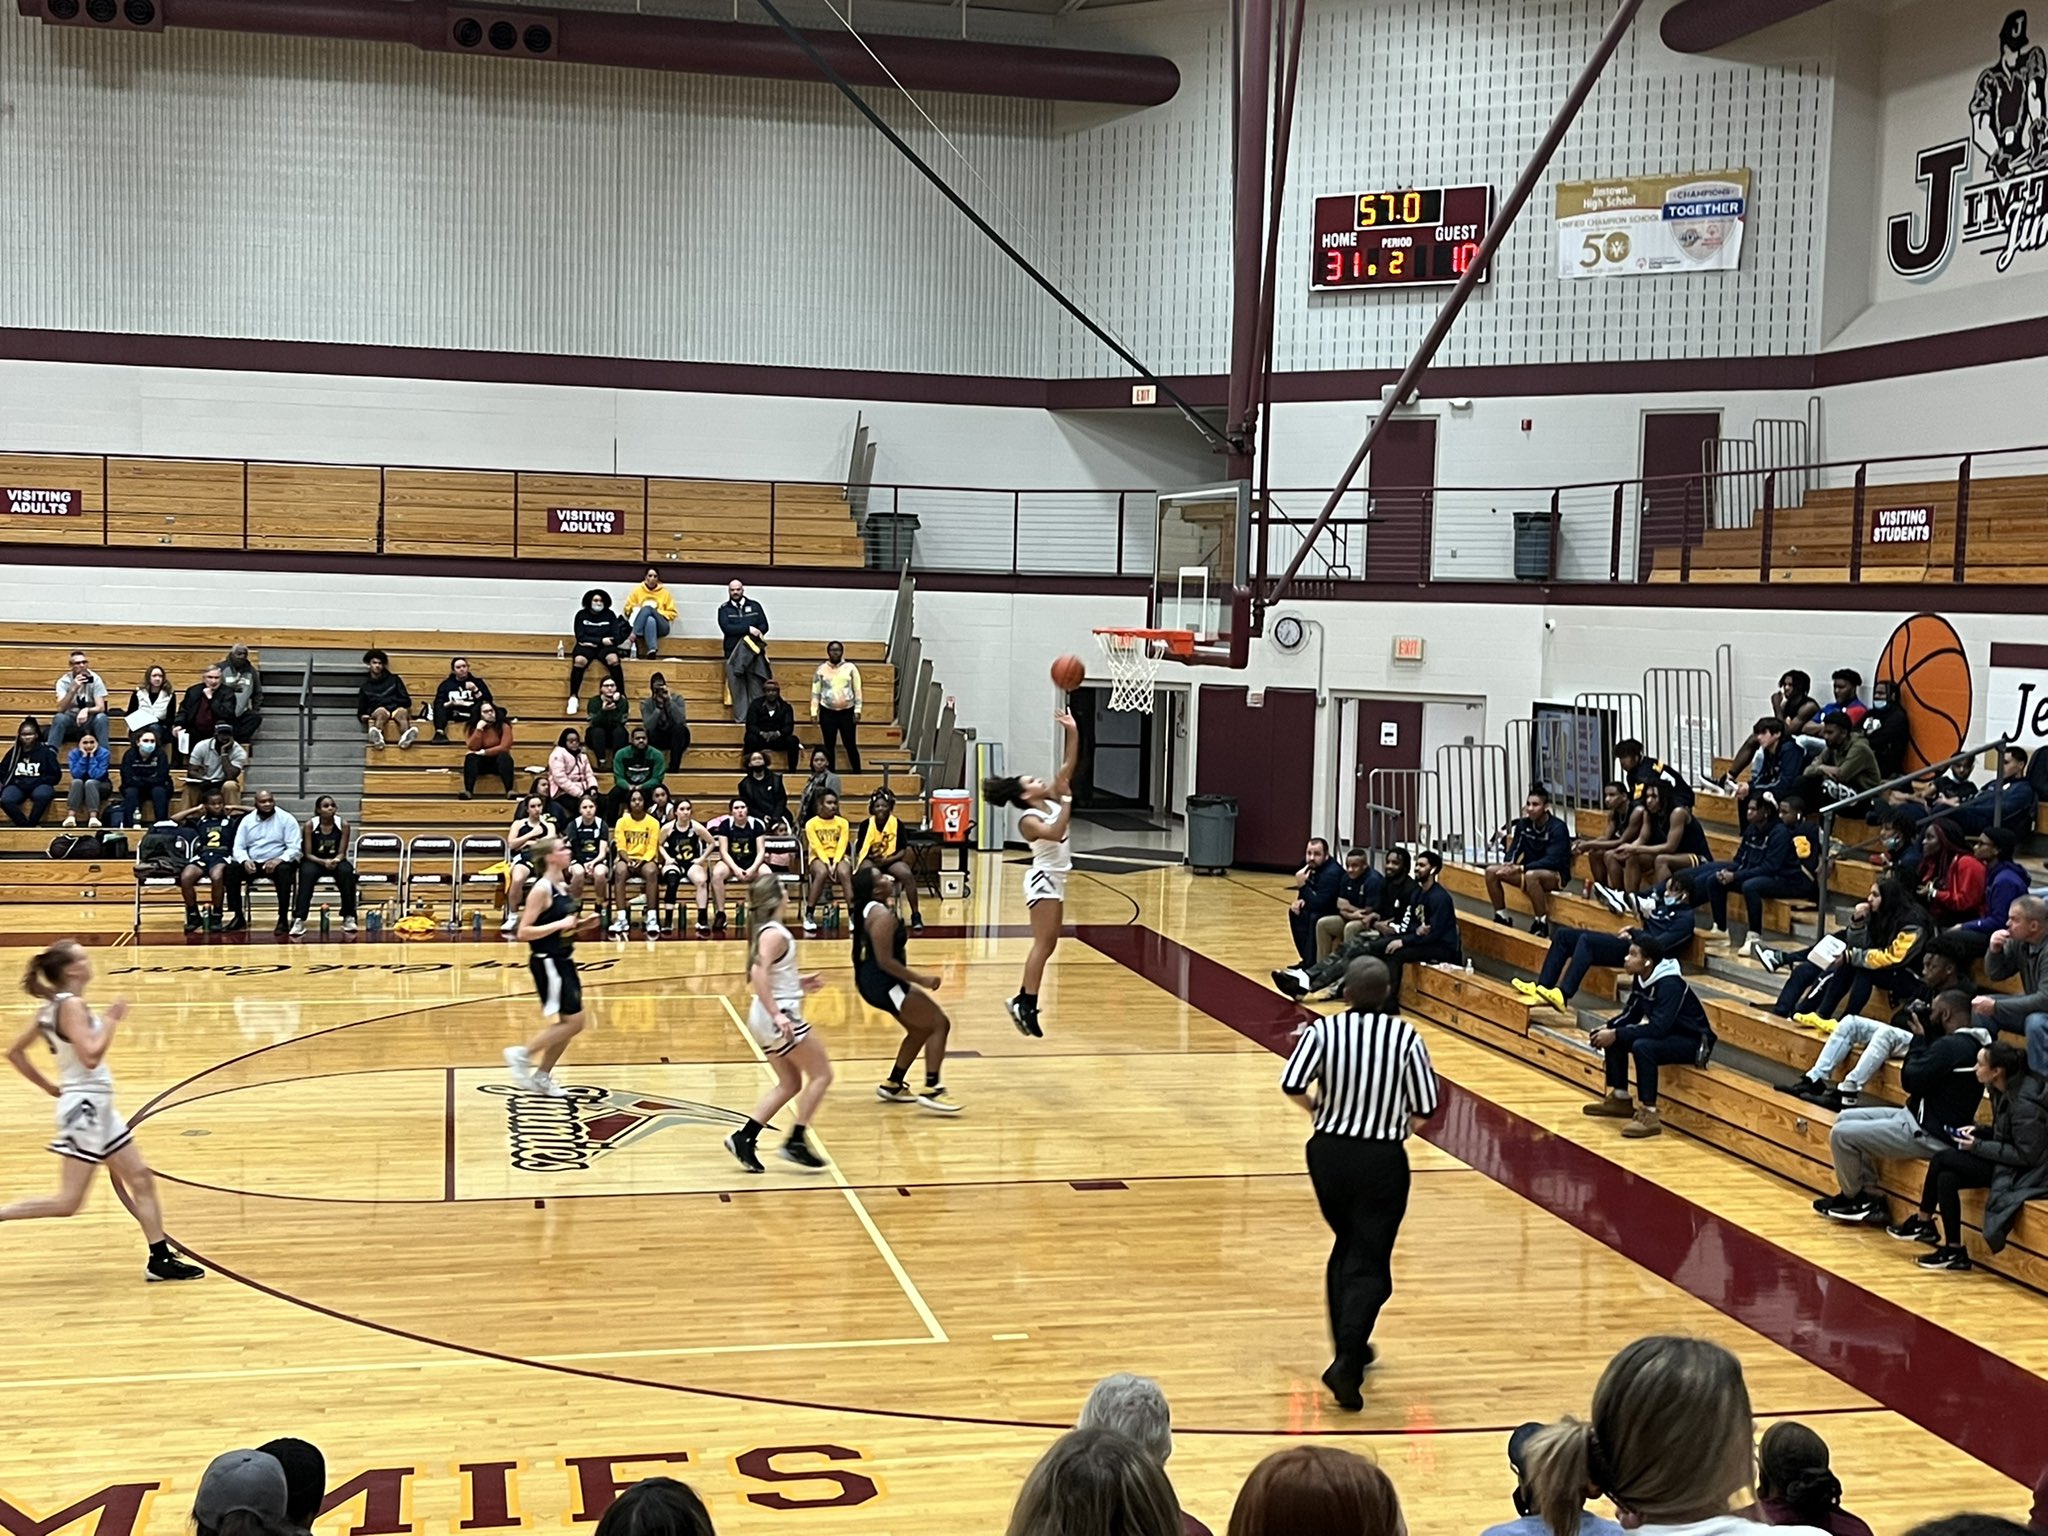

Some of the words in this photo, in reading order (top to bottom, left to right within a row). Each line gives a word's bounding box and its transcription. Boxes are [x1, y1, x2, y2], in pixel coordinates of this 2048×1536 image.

[1677, 188, 1731, 200] CHAMPIONS
[1360, 192, 1420, 225] 57.0
[1583, 198, 1602, 211] High
[1606, 195, 1637, 207] School
[1669, 202, 1739, 217] TOGETHER
[1587, 215, 1627, 226] CHAMPION
[1629, 213, 1659, 223] SCHOOL
[1322, 232, 1358, 248] HOME
[1435, 225, 1477, 241] GUEST
[1382, 236, 1412, 248] PERIOD
[6, 489, 72, 502] VISITING
[10, 501, 68, 514] ADULTS
[556, 509, 616, 522] VISITING
[1879, 509, 1927, 526] VISITING
[560, 521, 612, 533] ADULTS
[1873, 525, 1930, 542] STUDENTS
[1398, 640, 1418, 656] EXIT
[206, 831, 221, 848] 2
